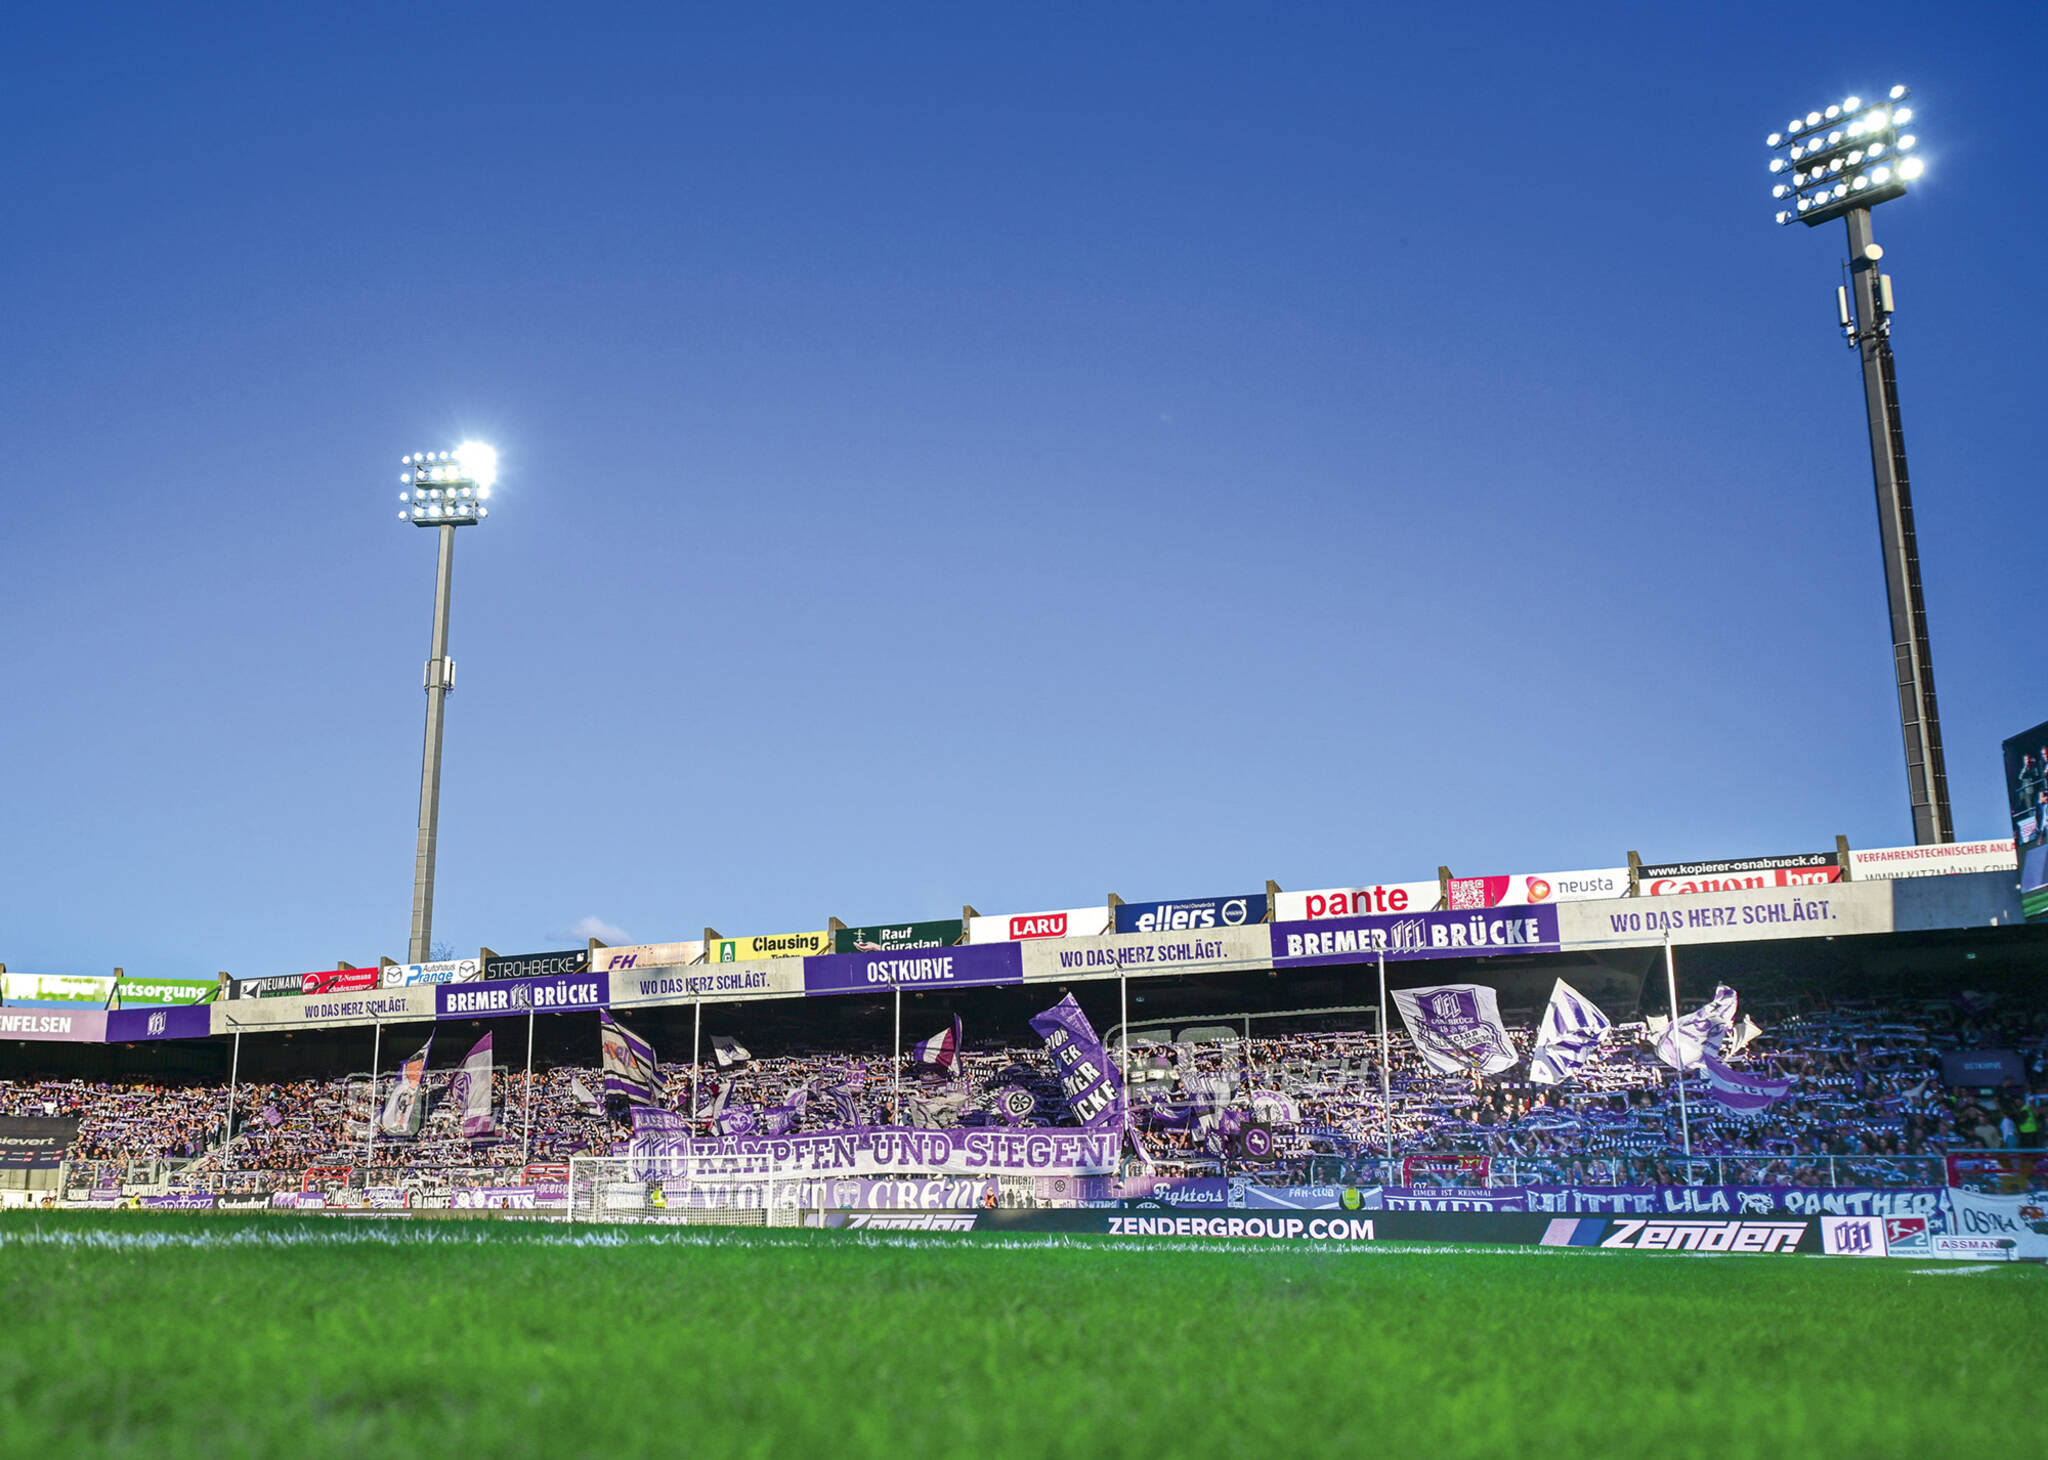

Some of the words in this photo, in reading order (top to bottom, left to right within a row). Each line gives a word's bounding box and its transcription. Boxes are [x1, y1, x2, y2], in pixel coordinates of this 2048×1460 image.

[1856, 844, 1988, 863] VERFAHRENSTECHNISCHER
[1648, 854, 1827, 877] www.kopierer-osnabrueck.de
[1558, 877, 1614, 893] neusta
[1305, 885, 1409, 921] pante
[1013, 918, 1064, 936] LARU
[1135, 904, 1216, 932] ellers
[1609, 909, 1642, 933] WO
[1646, 910, 1684, 930] DAS
[1689, 907, 1738, 928] HERZ
[1743, 898, 1837, 925] SCHLÄGT.
[753, 934, 819, 952] Clausing
[882, 927, 913, 940] Rauf
[1286, 928, 1388, 956] BREMER
[1431, 915, 1540, 947] BRÜCKE
[608, 954, 638, 970] FH
[1060, 951, 1082, 968] WO
[1087, 948, 1115, 967] DAS
[1118, 946, 1155, 964] HERZ
[1158, 940, 1228, 961] SCHLÄGT.
[422, 963, 456, 973] Autohaus
[487, 957, 575, 979] STROHBECKE
[867, 956, 954, 983] OSTKURVE
[118, 982, 207, 1003] ntsorgung
[260, 975, 303, 991] NEUMANN
[640, 980, 658, 995] WO
[660, 978, 683, 994] DAS
[685, 976, 714, 993] HERZ
[716, 970, 771, 991] SCHLÄGT.
[304, 1004, 319, 1019] WO
[321, 1003, 339, 1018] DAS
[341, 1001, 364, 1016] HERZ
[366, 996, 409, 1014] SCHLÄGT.
[446, 990, 508, 1012] BREMER
[533, 980, 599, 1006] BRÜCKE
[1432, 993, 1461, 1019] VFL
[0, 1015, 72, 1033] NFELSEN
[694, 1134, 857, 1174] KÄMPFEN
[870, 1133, 952, 1166] UND
[964, 1132, 1118, 1168] SIEGEN!
[1154, 1182, 1225, 1206] Fighters
[1413, 1189, 1437, 1197] EIMER
[1441, 1189, 1453, 1197] IST
[1458, 1189, 1492, 1197] KEINMAL
[1664, 1189, 1730, 1213] LILA
[1108, 1217, 1374, 1240] ZENDERGROUP.COM
[1834, 1220, 1874, 1253] VFL
[1914, 1232, 1927, 1246] 2
[1941, 1240, 2000, 1249] ASSMAN
